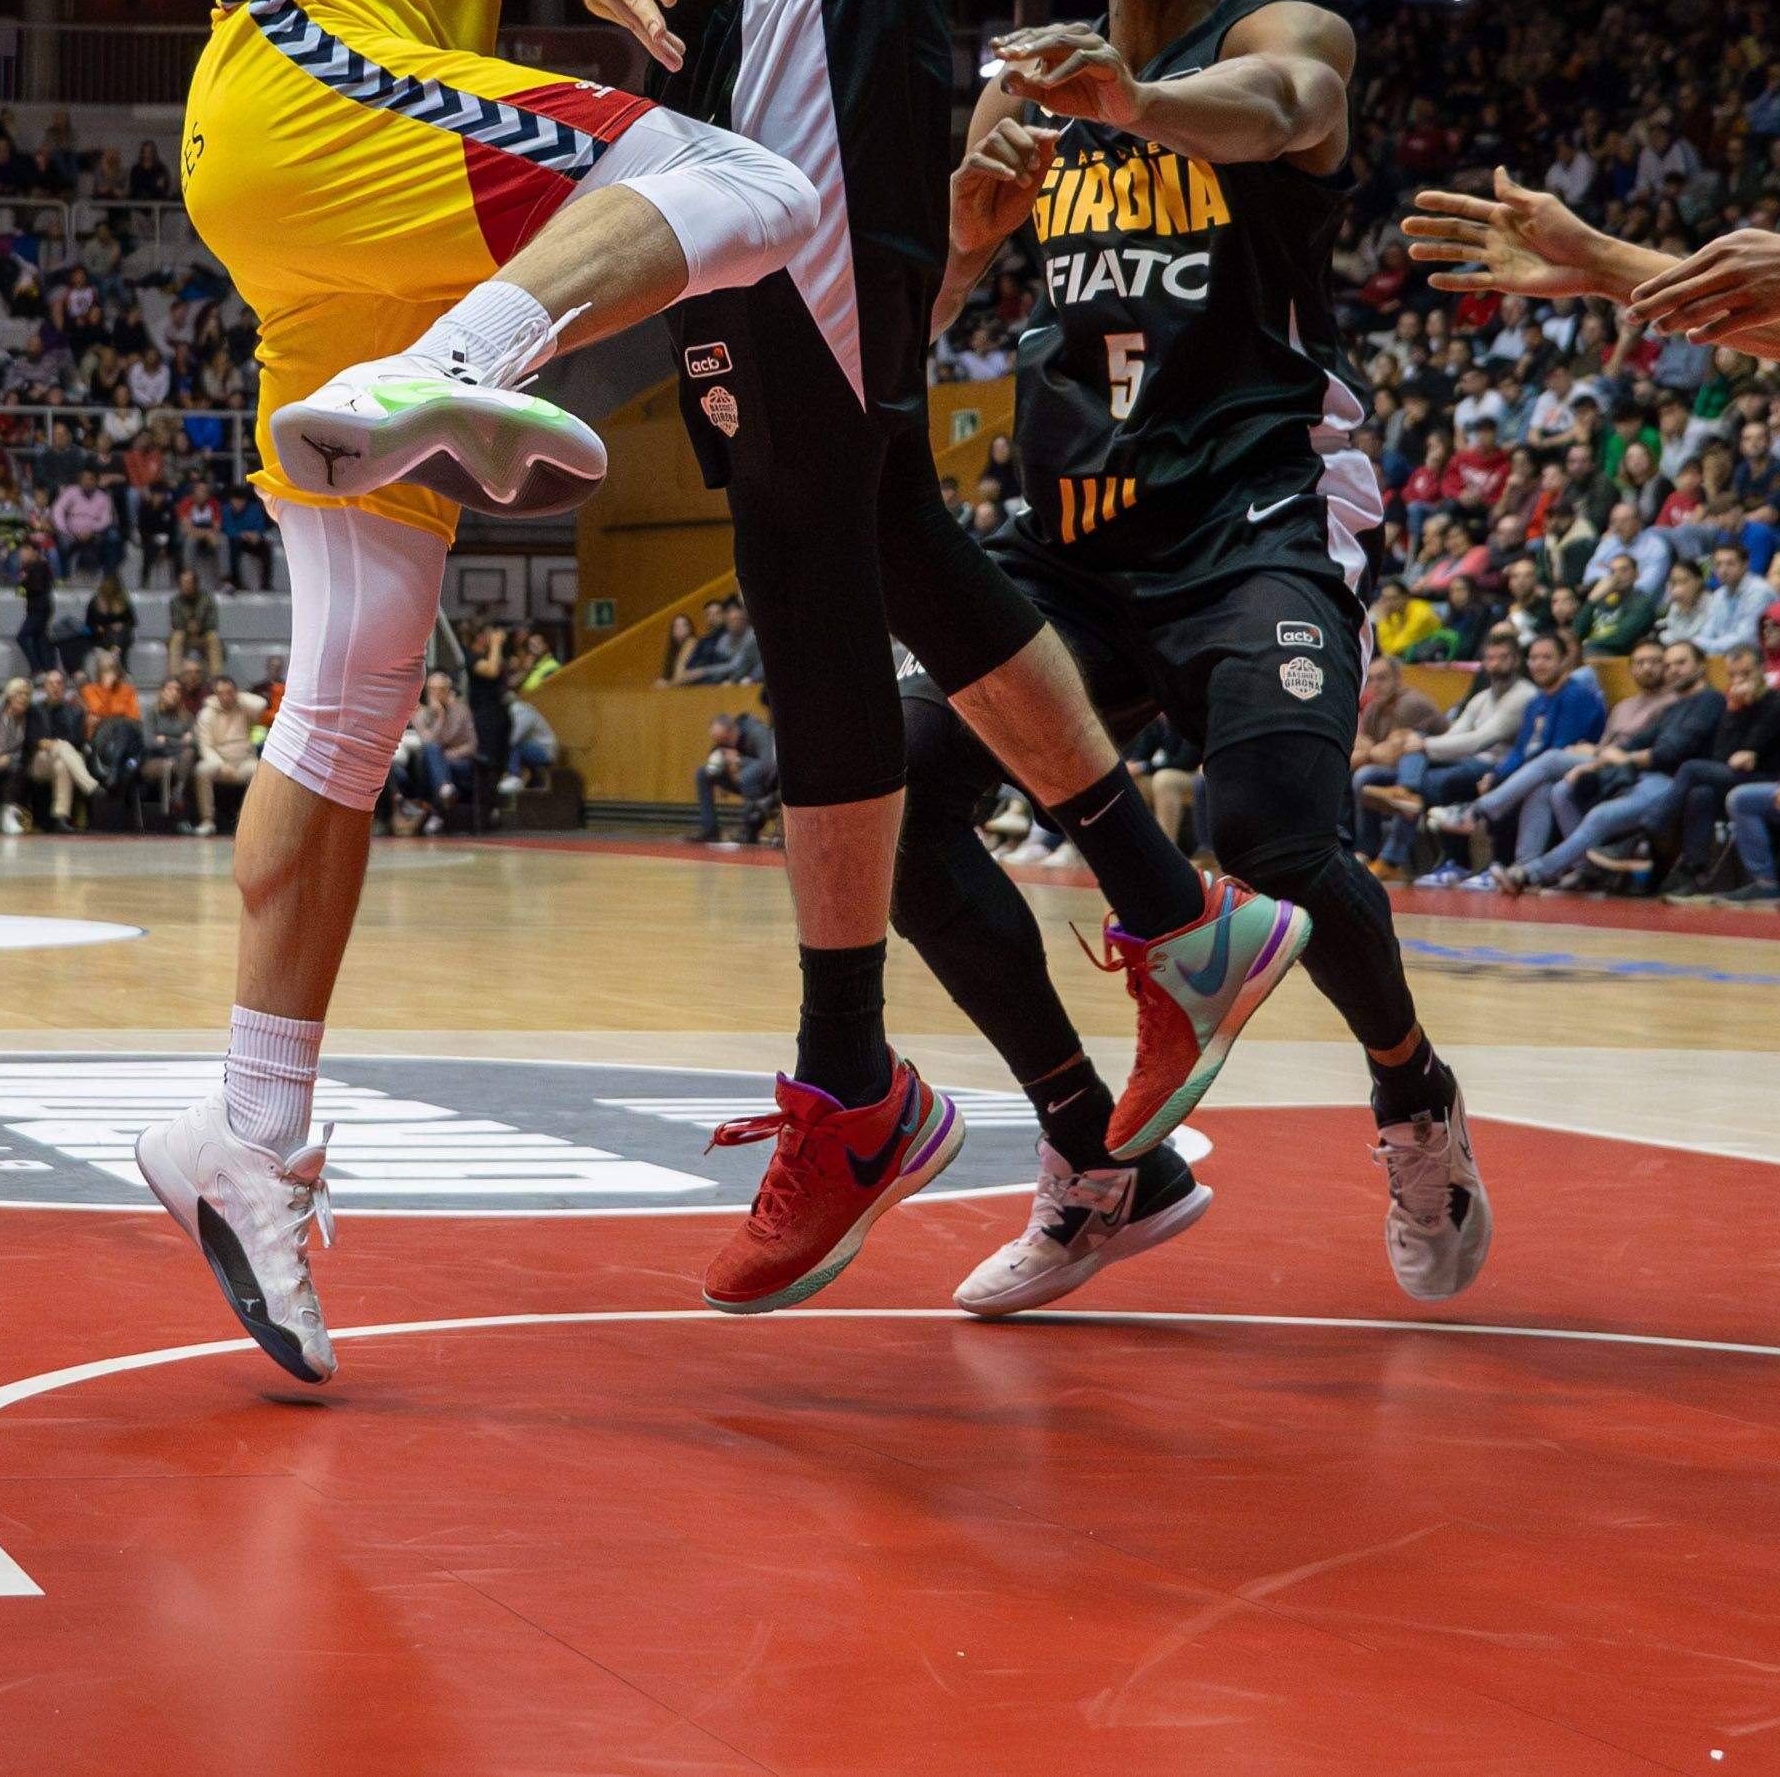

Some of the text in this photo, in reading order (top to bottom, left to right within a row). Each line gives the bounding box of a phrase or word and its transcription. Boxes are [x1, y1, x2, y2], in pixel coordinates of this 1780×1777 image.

[1031, 154, 1232, 245] GIRONA
[1045, 248, 1211, 309] FIATC
[691, 356, 720, 373] acb
[1103, 331, 1146, 420] 5
[1282, 630, 1314, 644] acb
